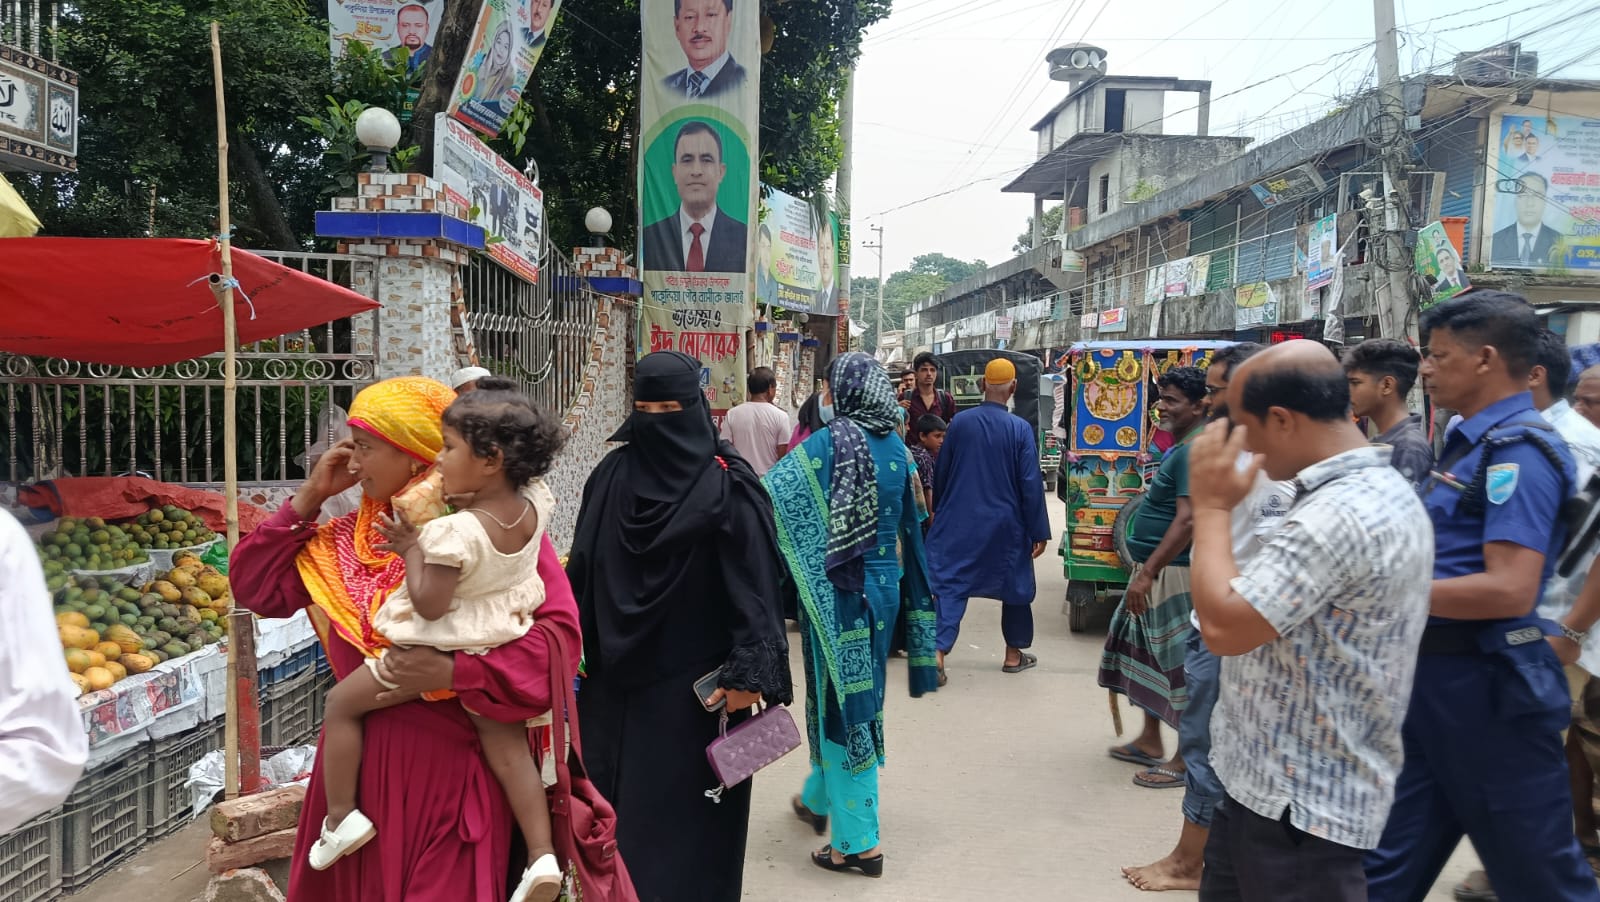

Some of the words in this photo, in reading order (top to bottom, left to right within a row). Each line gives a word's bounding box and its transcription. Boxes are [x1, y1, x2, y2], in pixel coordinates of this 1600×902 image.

[651, 289, 680, 305] পাকুন্দিয়া
[683, 289, 697, 304] পৌর
[699, 288, 722, 305] বাসীকে
[724, 290, 744, 304] জানাই
[672, 309, 711, 329] শুভেচ্ছা
[713, 310, 721, 328] ও
[650, 322, 674, 353] ঈদ
[679, 331, 741, 361] মোবারক
